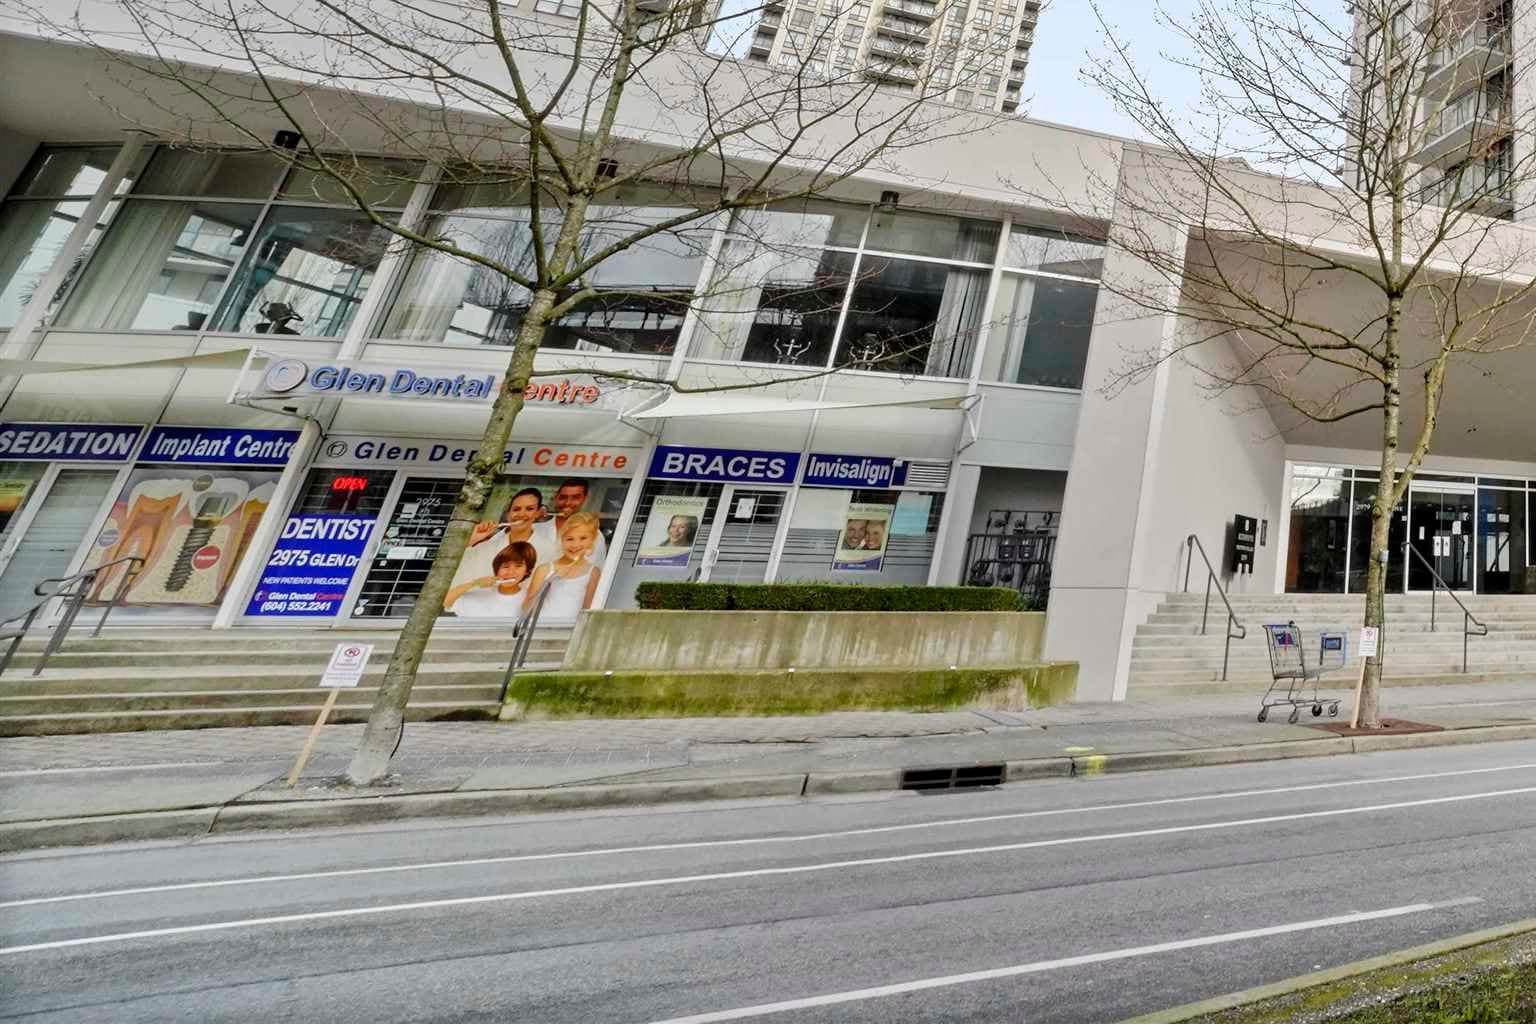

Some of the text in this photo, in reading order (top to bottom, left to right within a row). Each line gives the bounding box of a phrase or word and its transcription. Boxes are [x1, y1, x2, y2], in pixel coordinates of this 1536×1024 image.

[310, 366, 601, 405] Glen Dental entre
[0, 430, 136, 455] SEDATION
[151, 433, 230, 461] Implant
[354, 441, 628, 470] Glen Deal Centre
[662, 452, 786, 479] BRACES
[808, 456, 891, 485] Invisalign
[333, 477, 368, 491] OPEN
[281, 518, 377, 541] DENTIST
[268, 549, 311, 567] 2975
[309, 553, 347, 568] GLEN
[313, 577, 349, 586] WELCOME
[260, 602, 287, 613] (604)
[268, 592, 288, 601] Glen
[289, 592, 317, 601] Dental
